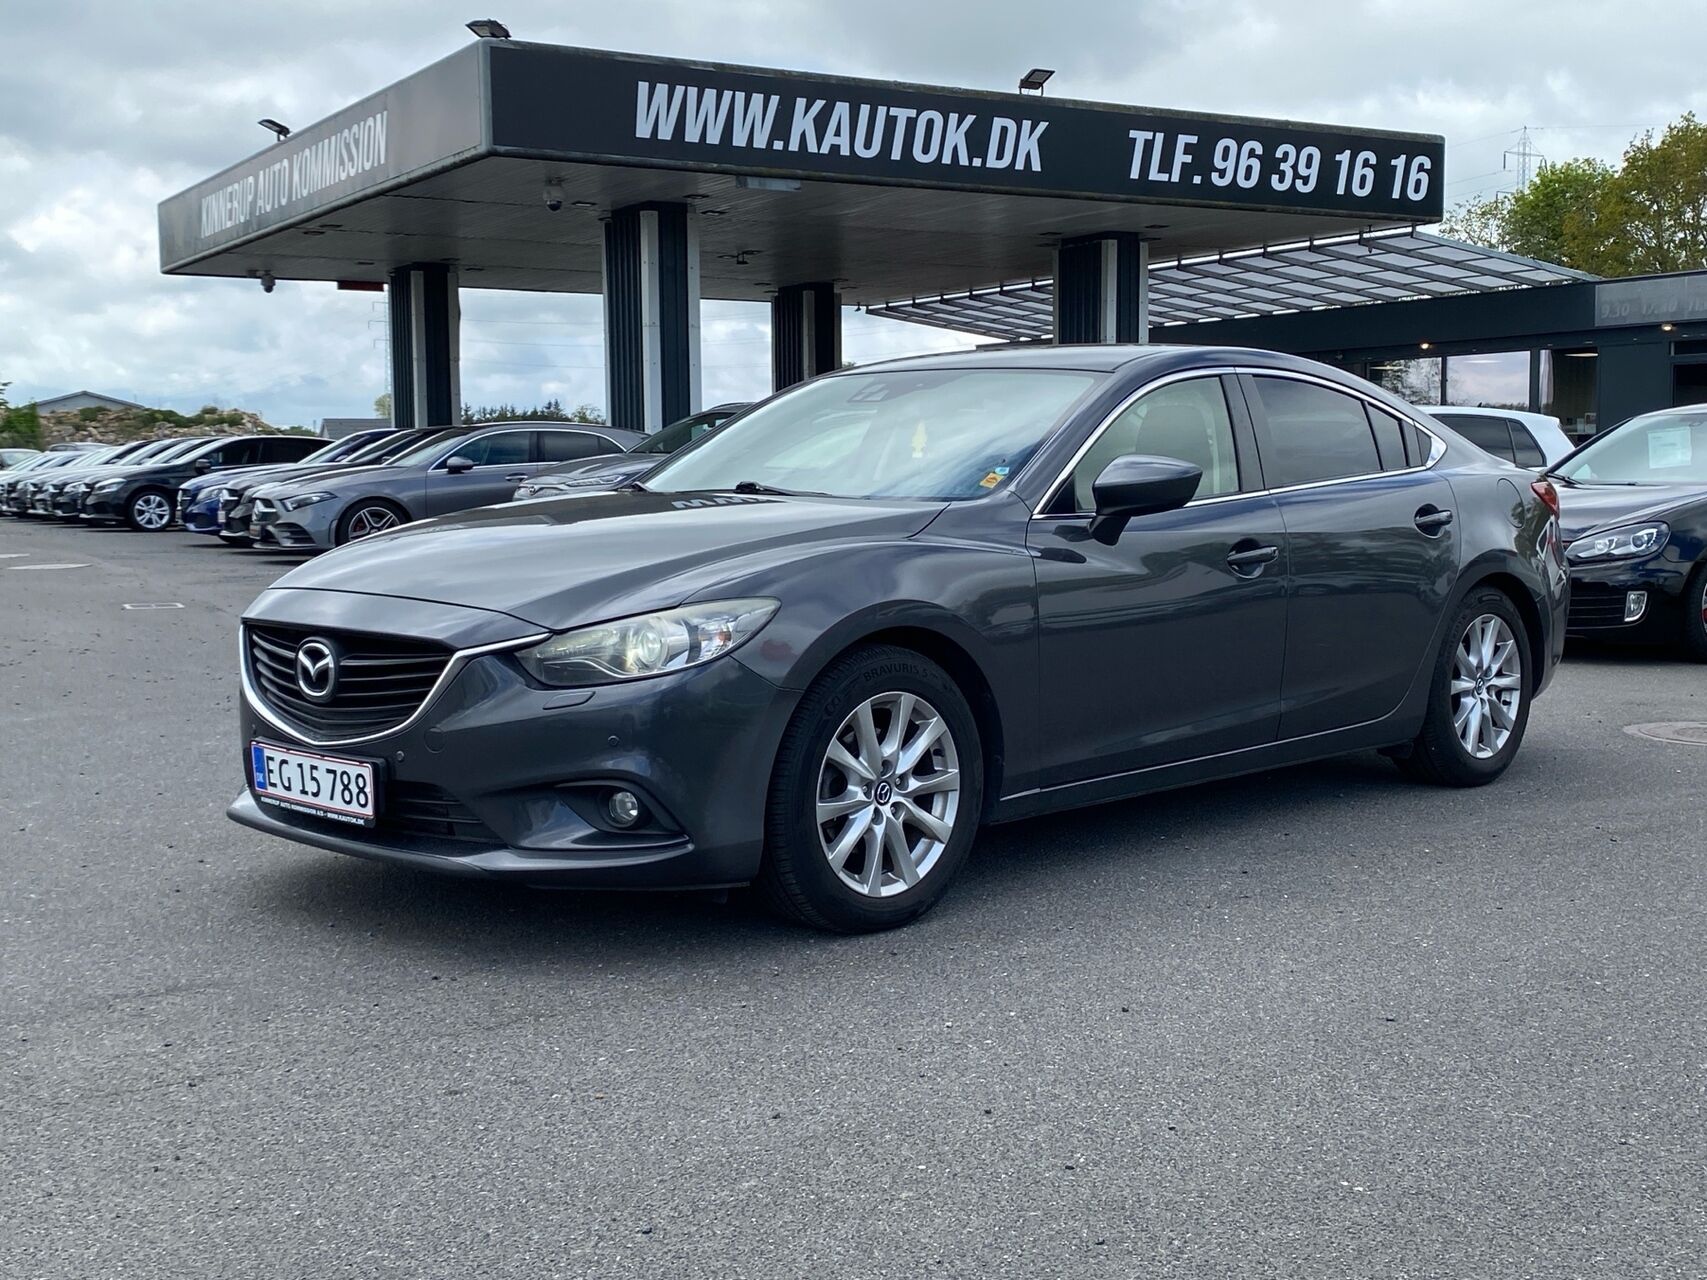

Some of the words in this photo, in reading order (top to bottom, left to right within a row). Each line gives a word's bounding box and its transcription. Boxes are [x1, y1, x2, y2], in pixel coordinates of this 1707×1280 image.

[635, 81, 1049, 172] WWW.KAUTOK.DK
[1129, 129, 1202, 184] TLF.
[1211, 138, 1263, 189] 96
[1271, 143, 1322, 194] 39
[1335, 149, 1377, 198] 16
[1390, 154, 1432, 202] 16
[201, 175, 255, 239] KINNERUP
[256, 159, 289, 216] AUTO
[292, 111, 388, 201] KOMMISSION
[265, 755, 292, 792] EG
[296, 762, 321, 798] 15
[325, 768, 370, 809] 788
